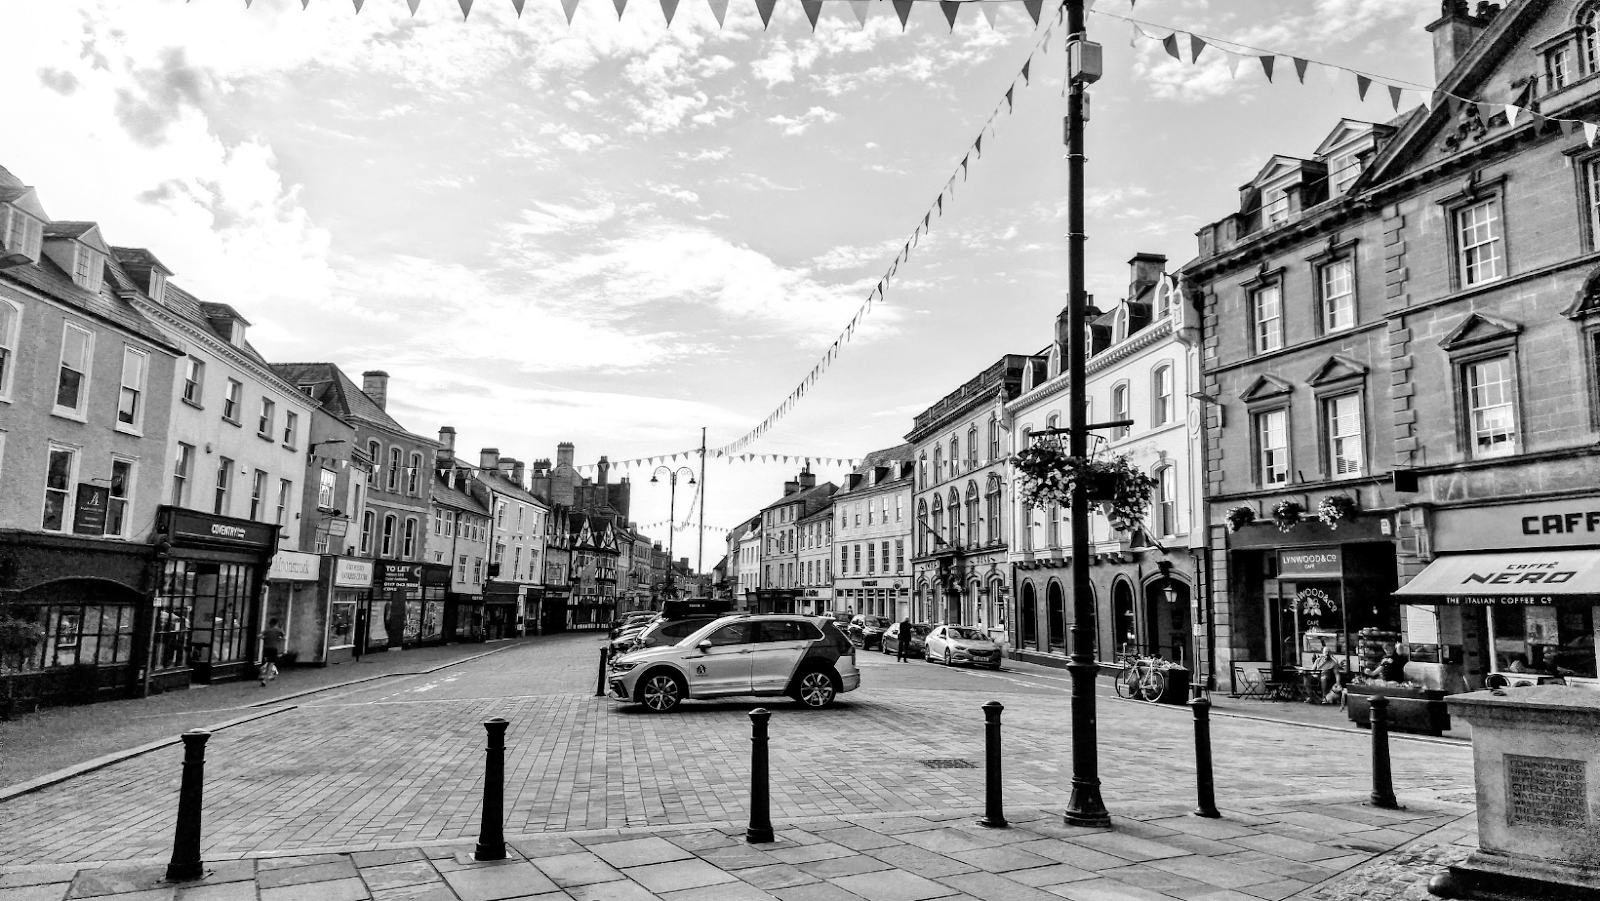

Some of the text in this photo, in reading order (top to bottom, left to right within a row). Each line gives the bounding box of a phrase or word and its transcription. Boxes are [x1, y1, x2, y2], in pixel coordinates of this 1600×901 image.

[211, 523, 239, 537] COVENTRY
[1460, 571, 1578, 584] NERO
[1561, 764, 1581, 773] WAS
